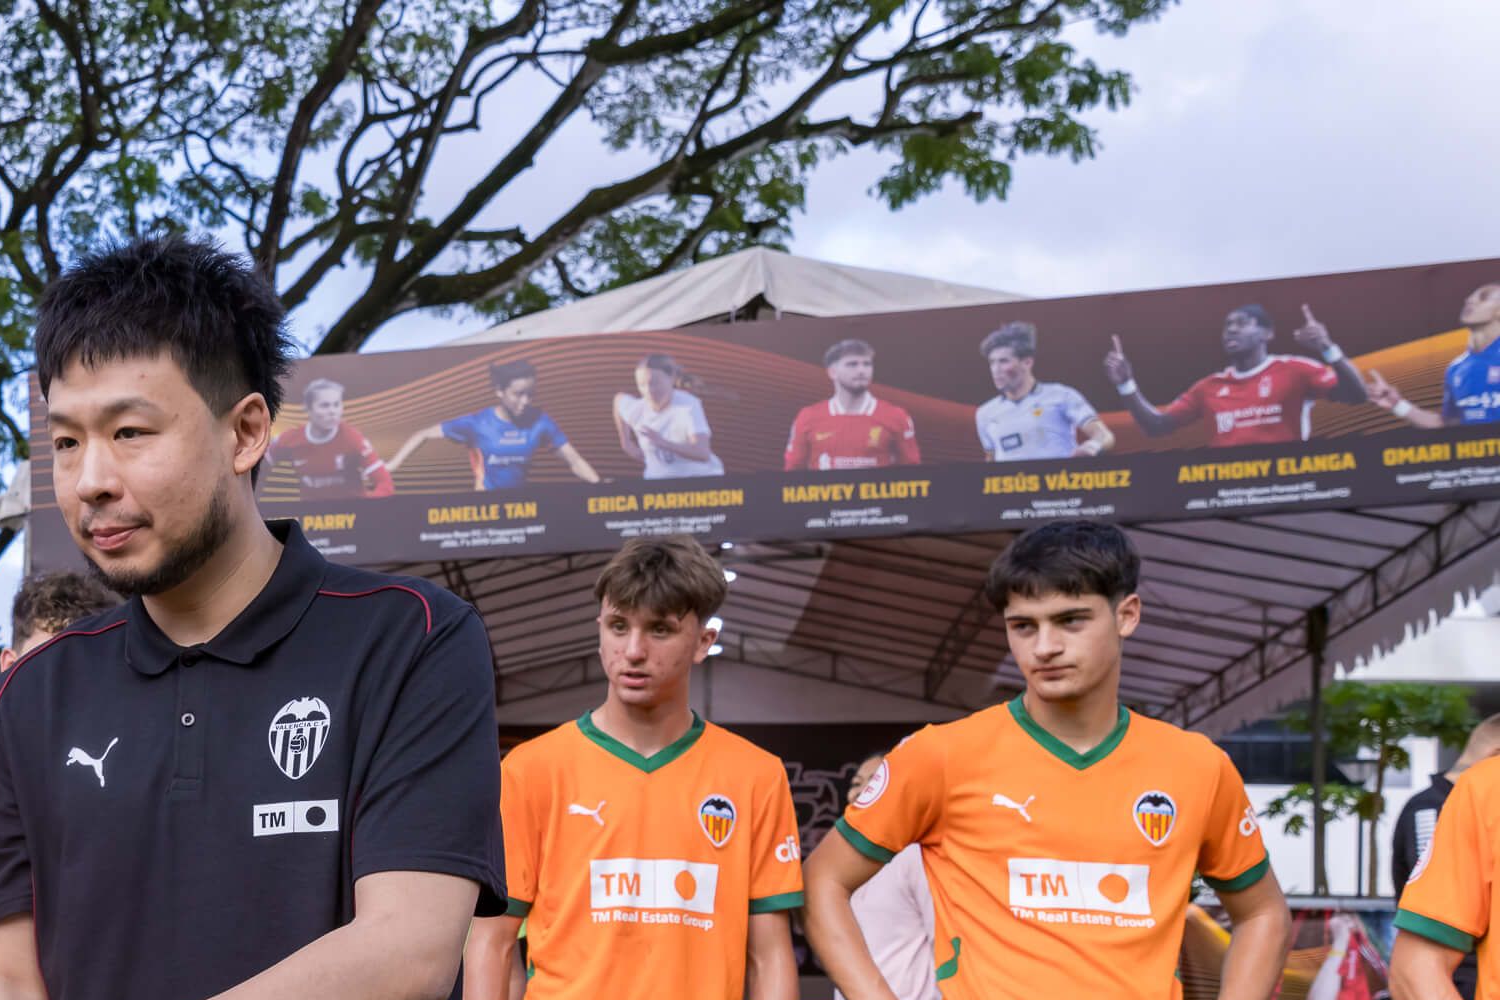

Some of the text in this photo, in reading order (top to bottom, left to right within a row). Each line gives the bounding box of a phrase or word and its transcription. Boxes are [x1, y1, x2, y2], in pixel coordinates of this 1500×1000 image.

[1383, 438, 1500, 467] OMARI HUT
[1177, 452, 1356, 483] ANTHONY ELANGA
[782, 480, 931, 503] HARVEY ELLIOTT
[983, 469, 1131, 494] JESÚS VÁZQUEZ
[428, 501, 537, 525] DANELLE TAN
[587, 489, 743, 514] ERICA PARKINSON
[302, 513, 356, 531] PARRY
[275, 721, 311, 730] VALENCIA
[258, 811, 286, 829] TM
[600, 873, 641, 897] TM
[1019, 873, 1069, 897] TM
[591, 909, 714, 931] TM Real Estate Group
[1011, 907, 1156, 929] TM Real Estate Group
